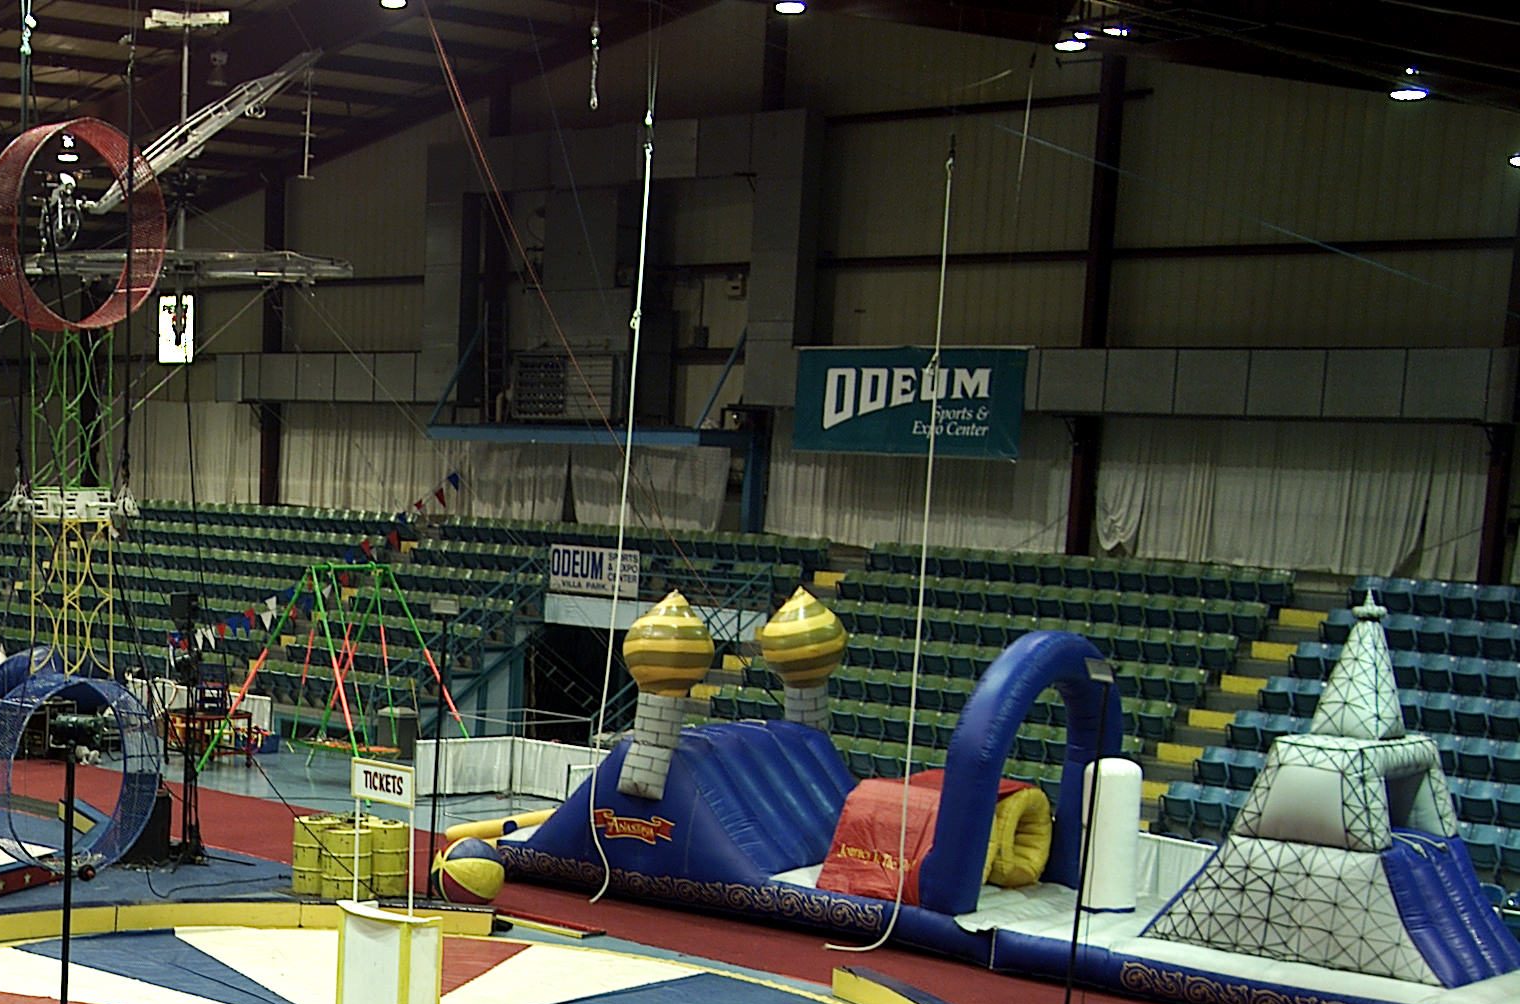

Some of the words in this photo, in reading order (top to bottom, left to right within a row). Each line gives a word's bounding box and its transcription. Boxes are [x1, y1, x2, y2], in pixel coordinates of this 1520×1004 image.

[823, 368, 992, 430] ODEUM
[934, 405, 974, 424] Sports
[976, 405, 990, 420] &
[947, 421, 989, 436] Center
[552, 548, 603, 579] ODEUM
[608, 552, 638, 563] SPRTS
[616, 563, 638, 573] XPO
[363, 770, 403, 796] TICKETS
